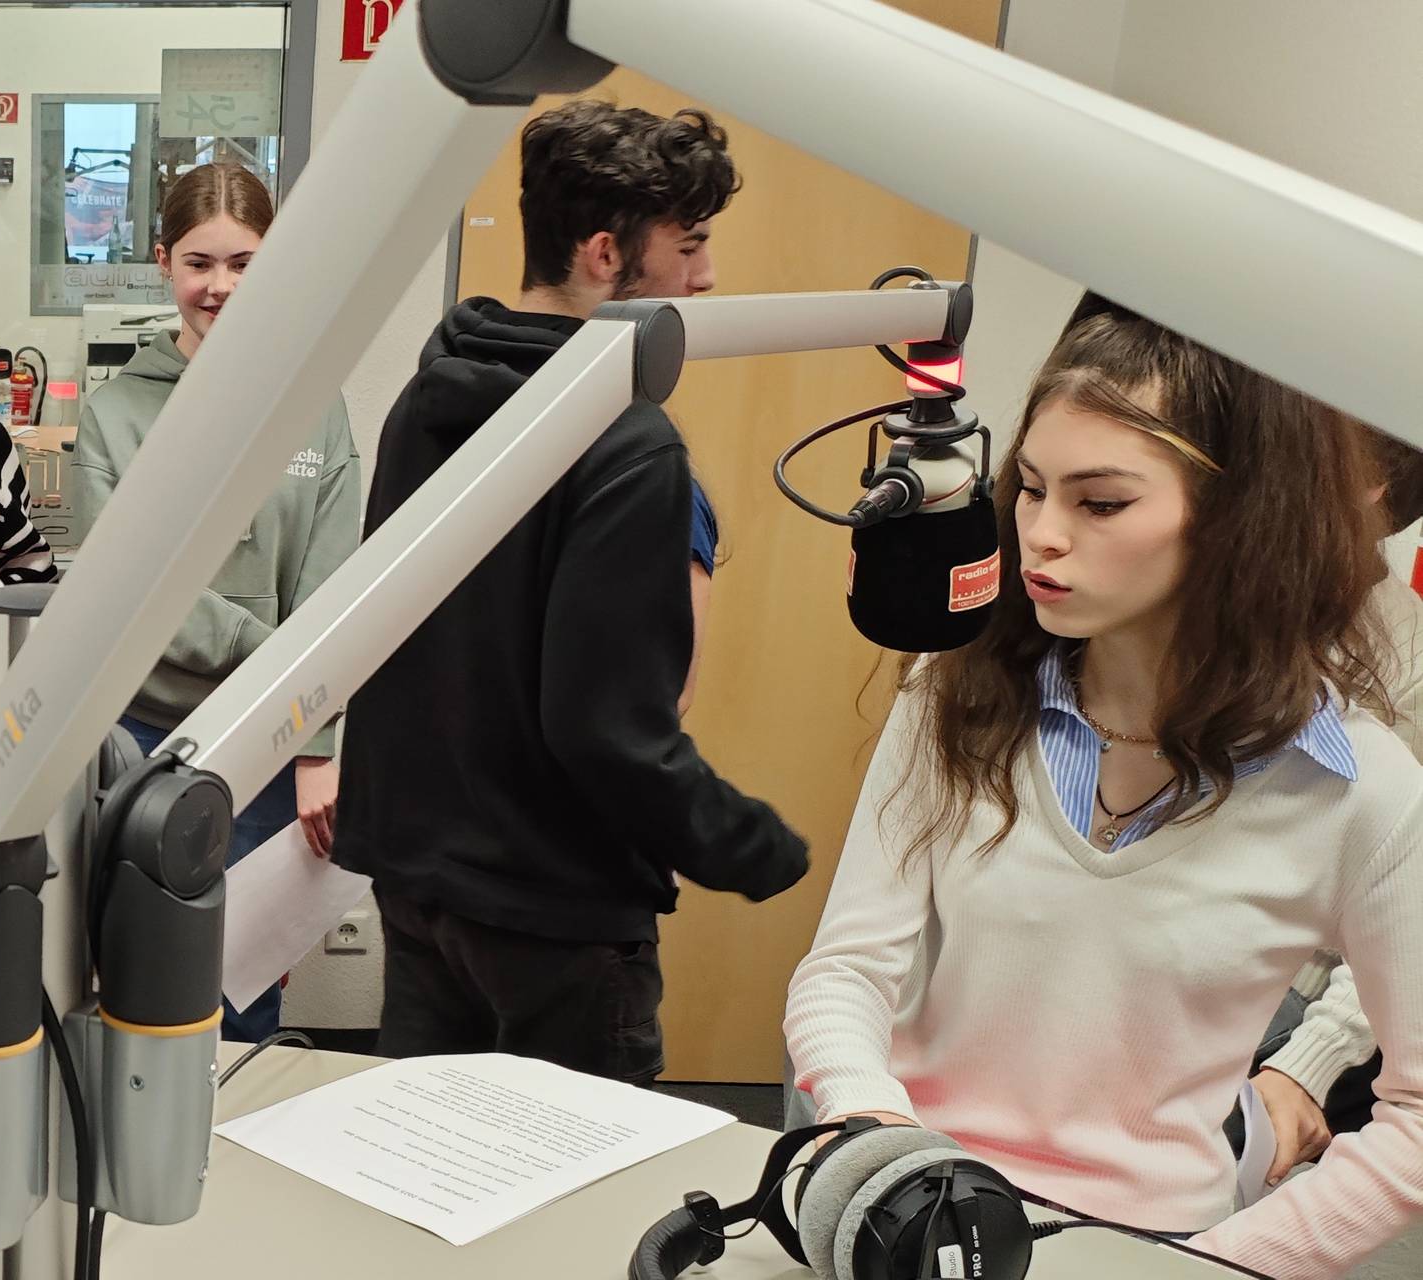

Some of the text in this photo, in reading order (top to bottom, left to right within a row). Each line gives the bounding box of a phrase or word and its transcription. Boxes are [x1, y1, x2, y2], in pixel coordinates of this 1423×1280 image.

[291, 447, 324, 465] cha
[284, 462, 317, 478] atte
[958, 566, 988, 581] radio
[271, 683, 328, 753] mika
[948, 1251, 957, 1277] Studio
[971, 1253, 982, 1278] PRO
